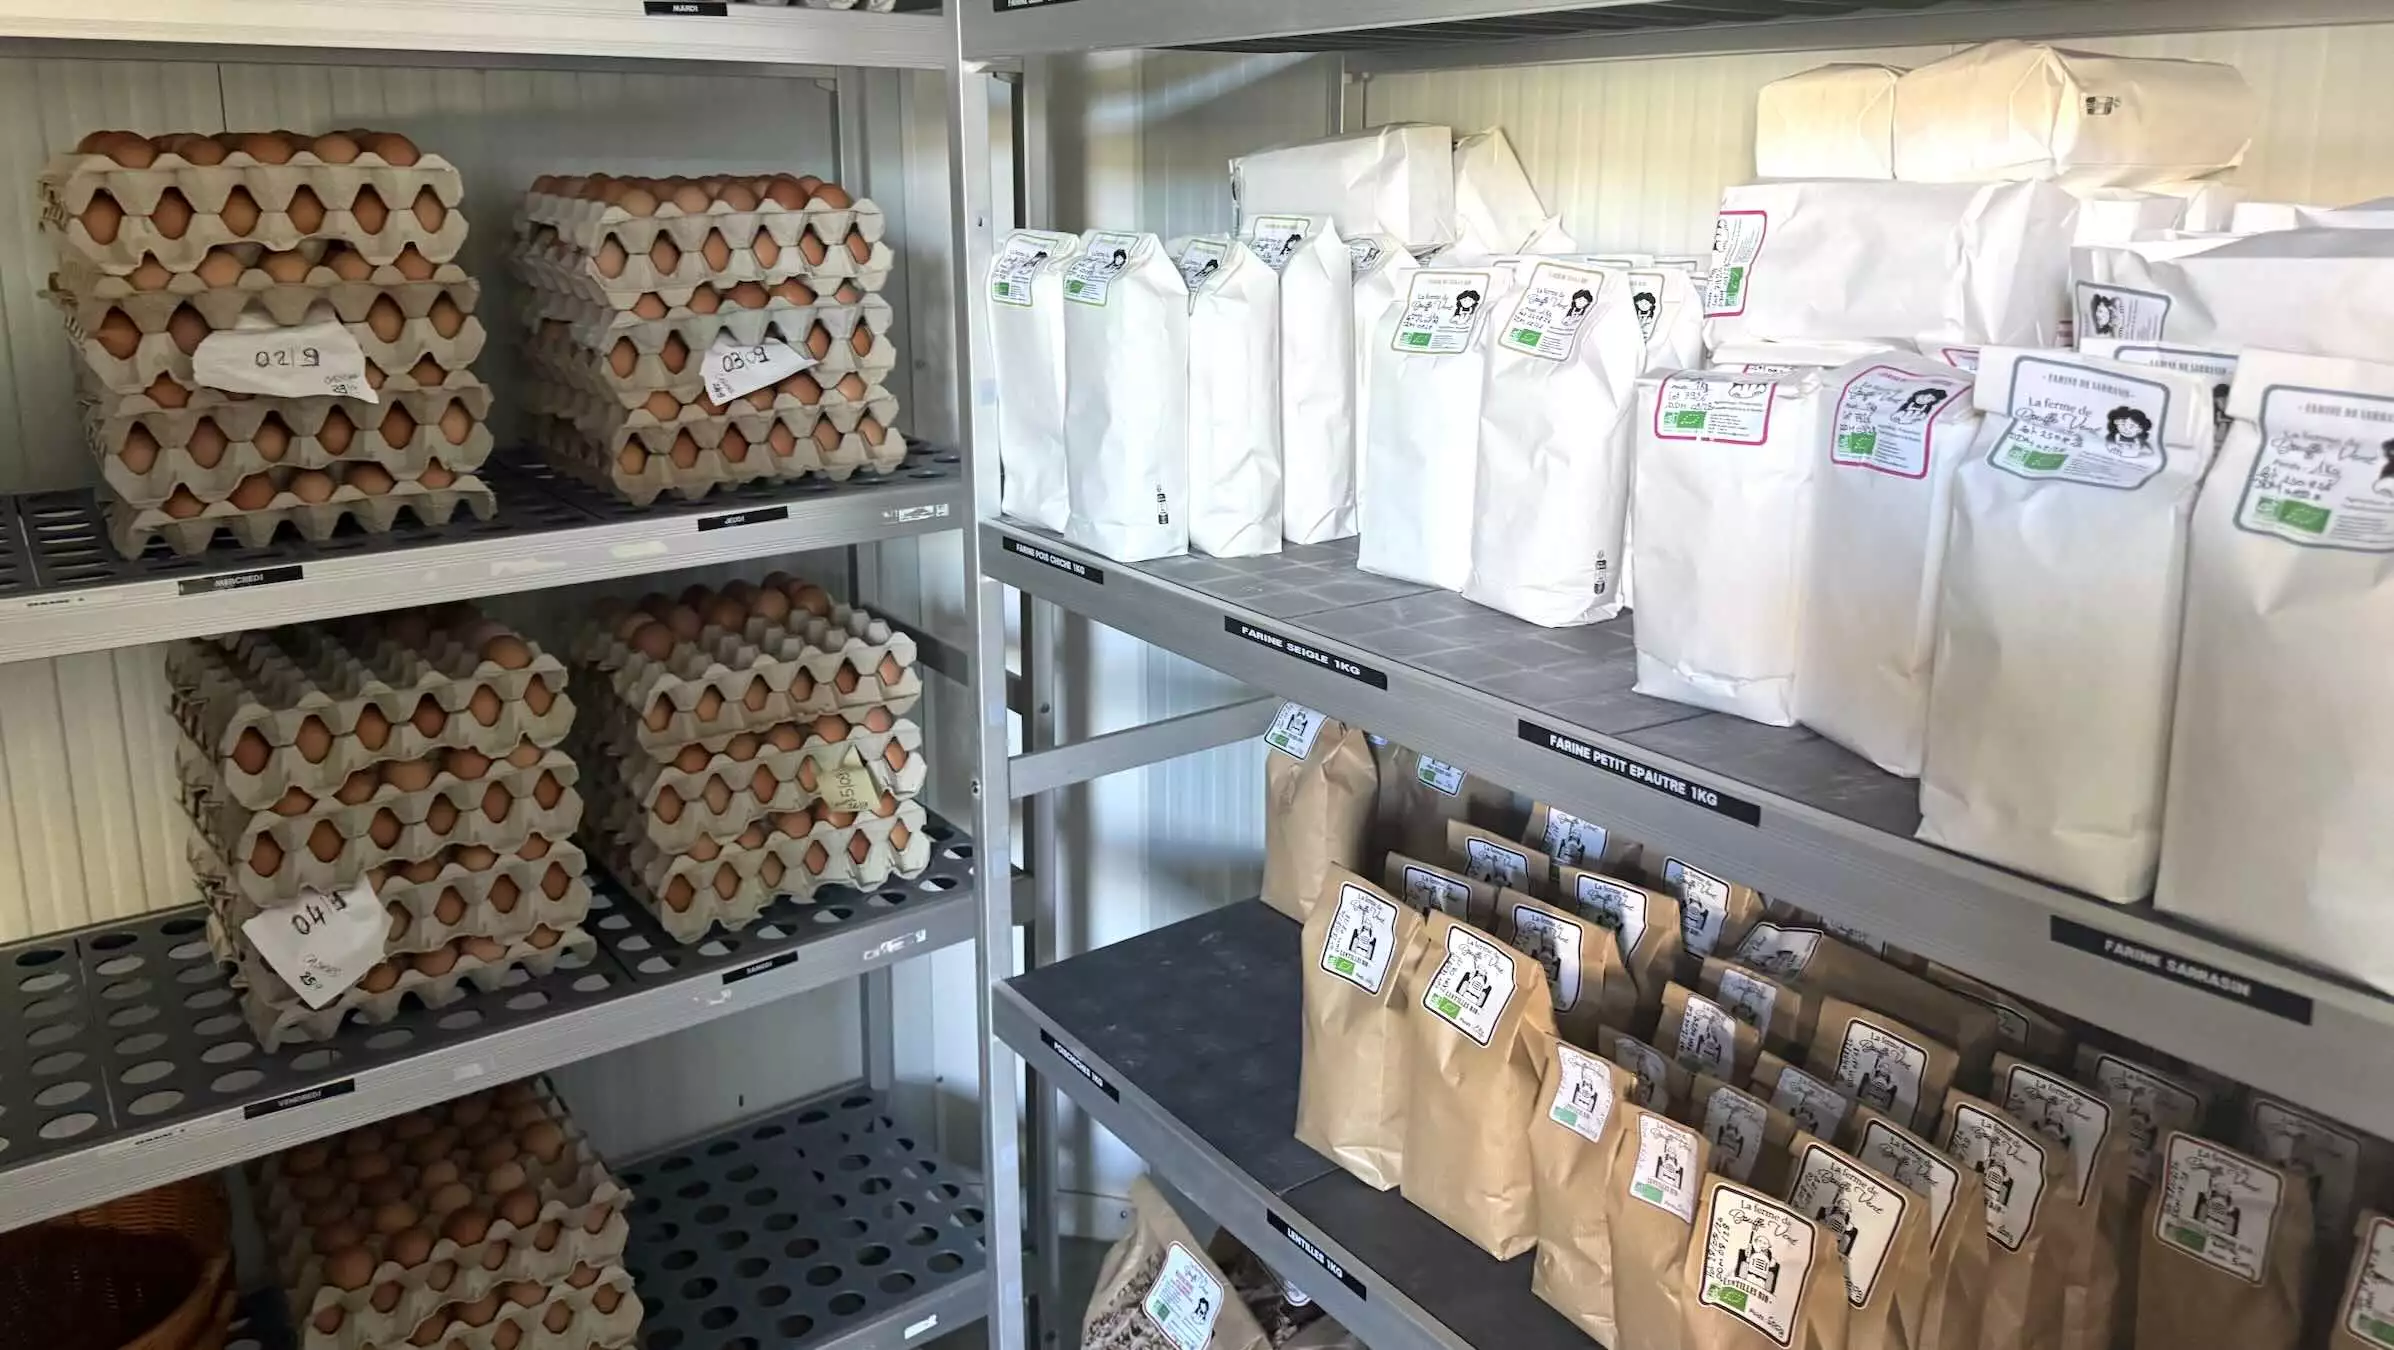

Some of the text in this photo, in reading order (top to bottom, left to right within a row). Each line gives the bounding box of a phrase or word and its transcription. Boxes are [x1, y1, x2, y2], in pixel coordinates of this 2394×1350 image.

[2049, 374, 2077, 388] FARINE
[2029, 396, 2092, 417] La ferme de
[1016, 543, 1035, 557] FARINE
[1050, 555, 1072, 570] CHICHE
[1072, 563, 1086, 575] 1KG
[215, 573, 264, 588] MERCREDI
[1241, 625, 1361, 676] FARINE SEIGLE 1KG
[1550, 735, 1718, 807] FARINE PETIT EPAUTRE 1KG
[2104, 939, 2251, 996] FARINE SARRASIN
[1445, 991, 1470, 1010] LENTILLES
[1091, 1071, 1104, 1088] 1KG
[278, 1089, 322, 1108] VENDREDI
[1831, 1163, 1840, 1172] La
[1842, 1167, 1866, 1190] ferme
[1741, 1200, 1751, 1210] La
[1754, 1204, 1781, 1221] ferme
[1287, 1227, 1343, 1279] LENTILLES 1KG
[1722, 1277, 1770, 1304] LENTILLES BIO
